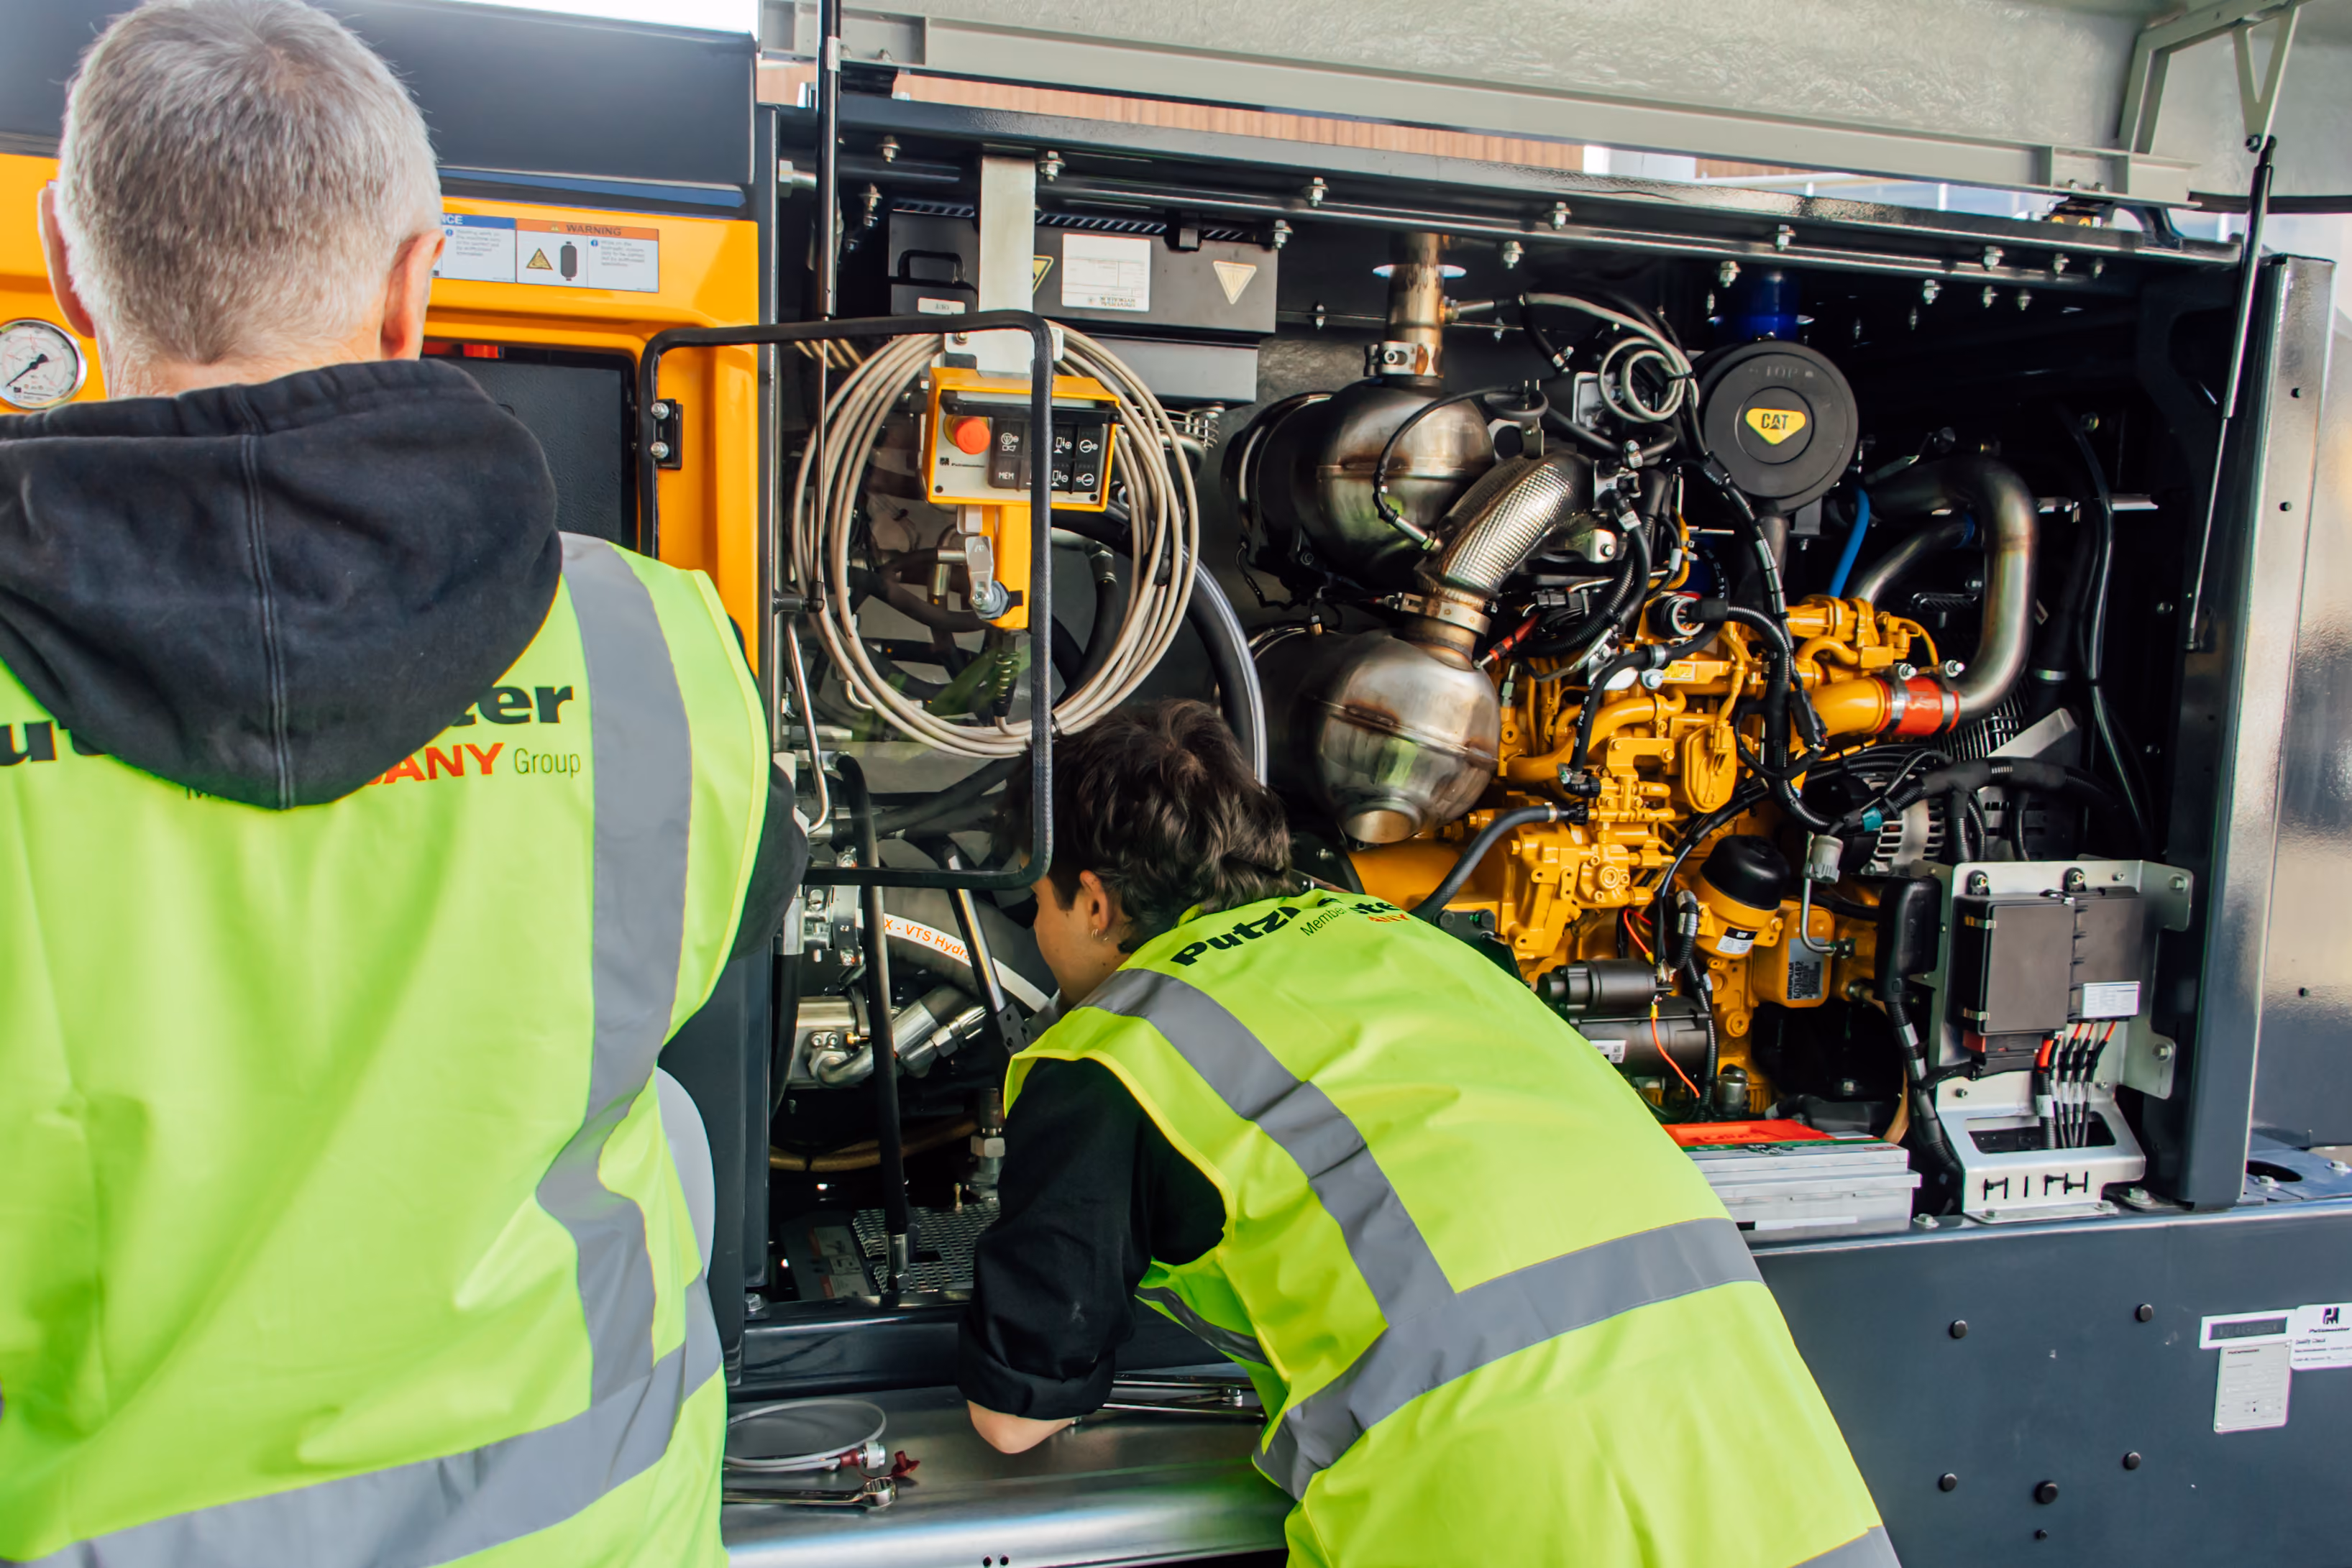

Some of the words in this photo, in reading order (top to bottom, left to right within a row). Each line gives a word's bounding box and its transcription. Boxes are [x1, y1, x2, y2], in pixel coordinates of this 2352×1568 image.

[566, 224, 622, 237] WARNING
[1762, 413, 1789, 430] CAT
[999, 471, 1015, 480] MEM
[365, 742, 505, 785] ANY
[513, 748, 581, 779] Group
[906, 924, 933, 943] VTS
